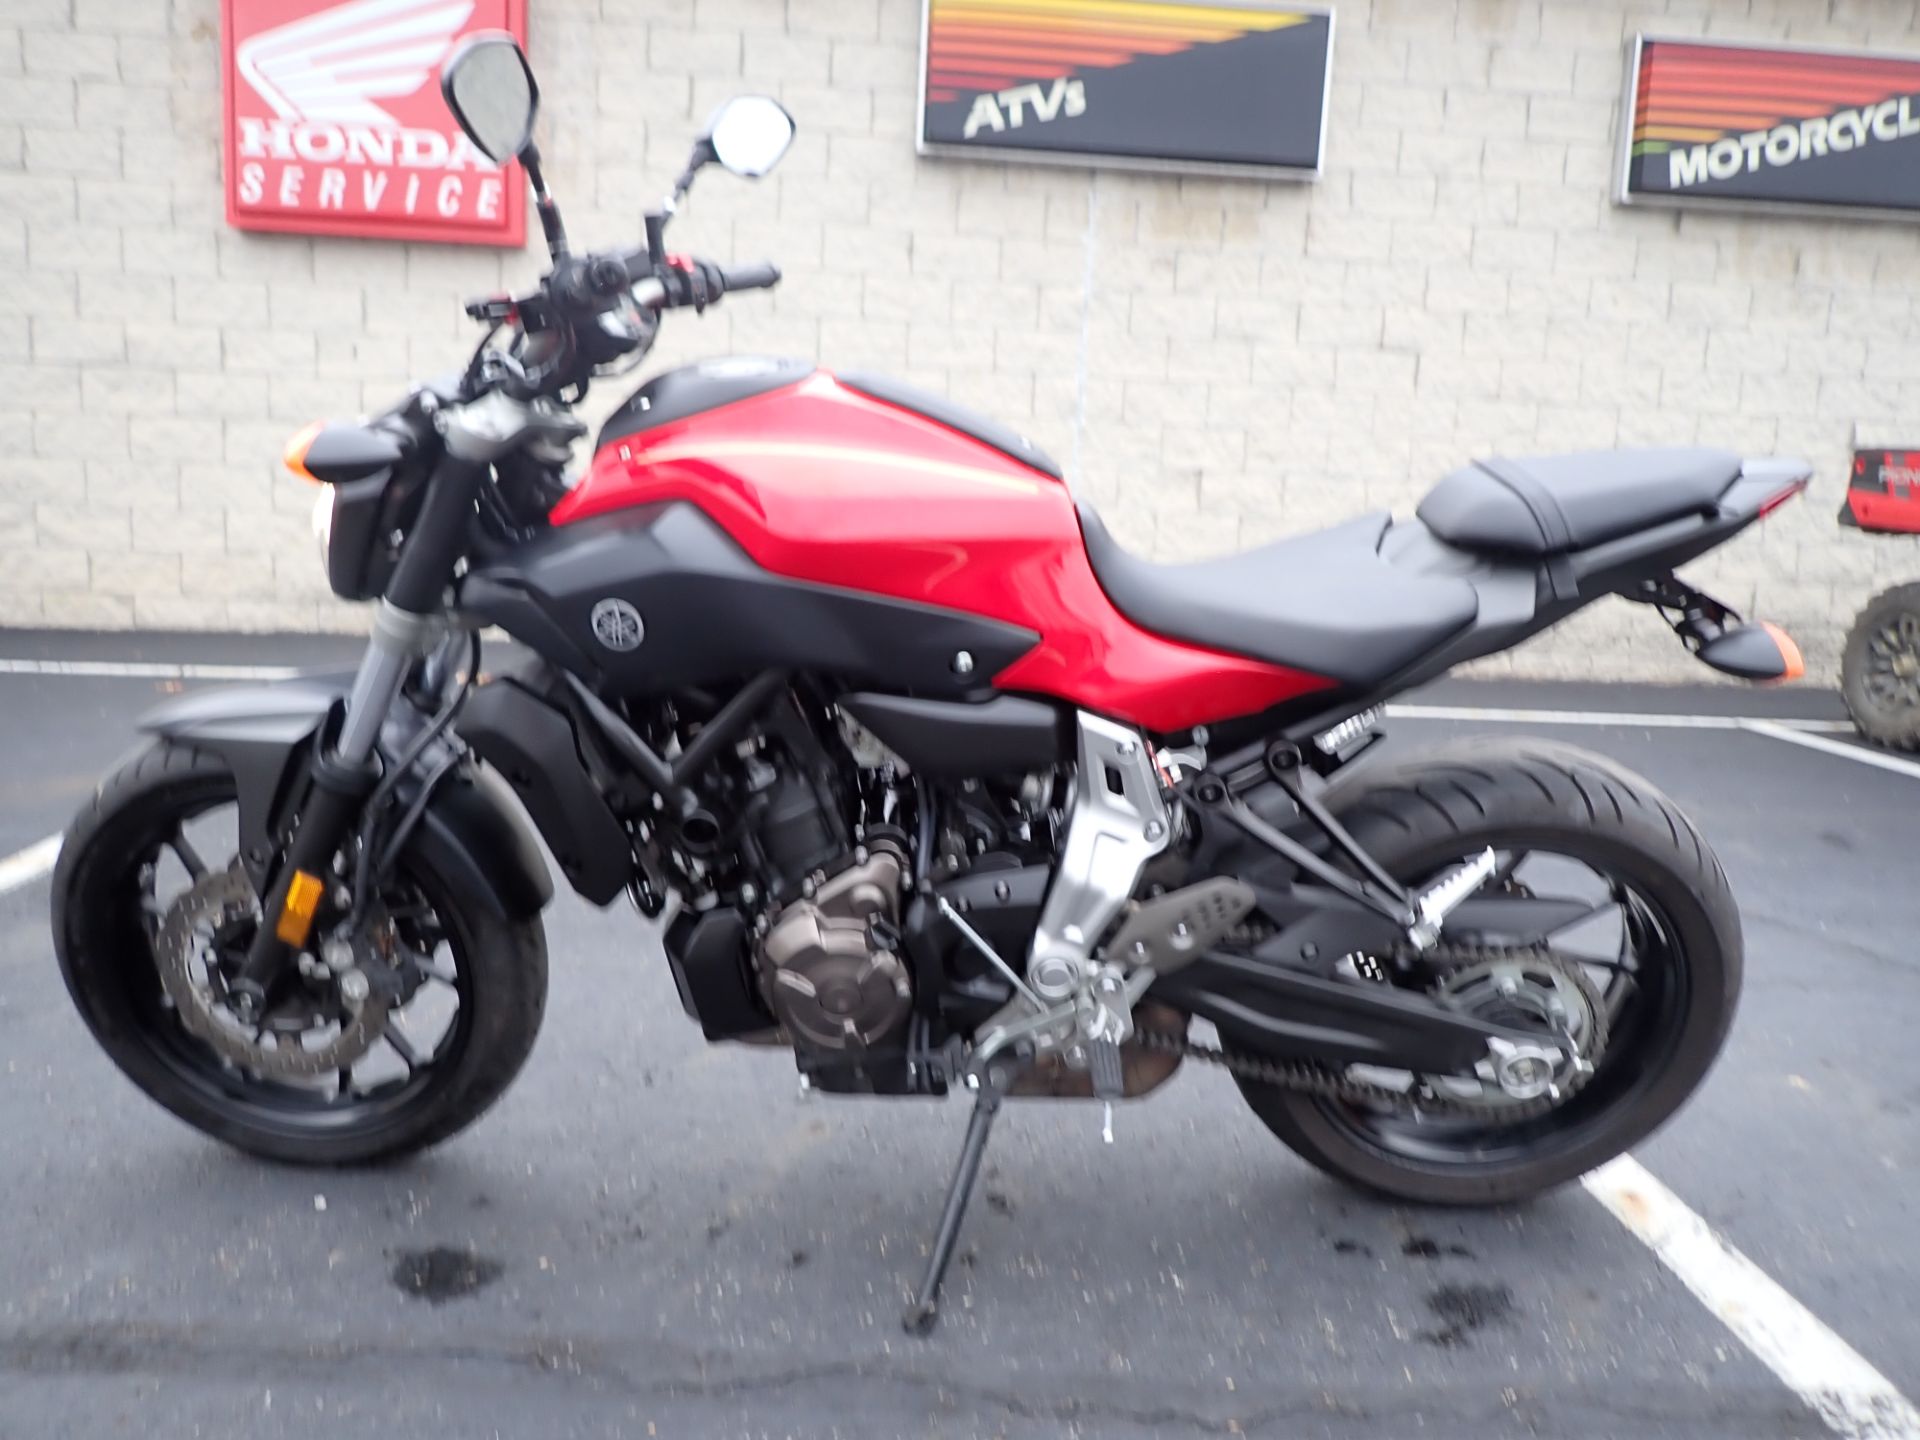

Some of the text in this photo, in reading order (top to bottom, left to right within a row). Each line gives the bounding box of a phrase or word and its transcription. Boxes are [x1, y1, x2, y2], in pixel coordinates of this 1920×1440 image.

[963, 77, 1086, 139] ATVs
[238, 117, 501, 172] HONDA
[1669, 96, 1920, 189] MOTORCYCL
[239, 162, 502, 219] SERVICE
